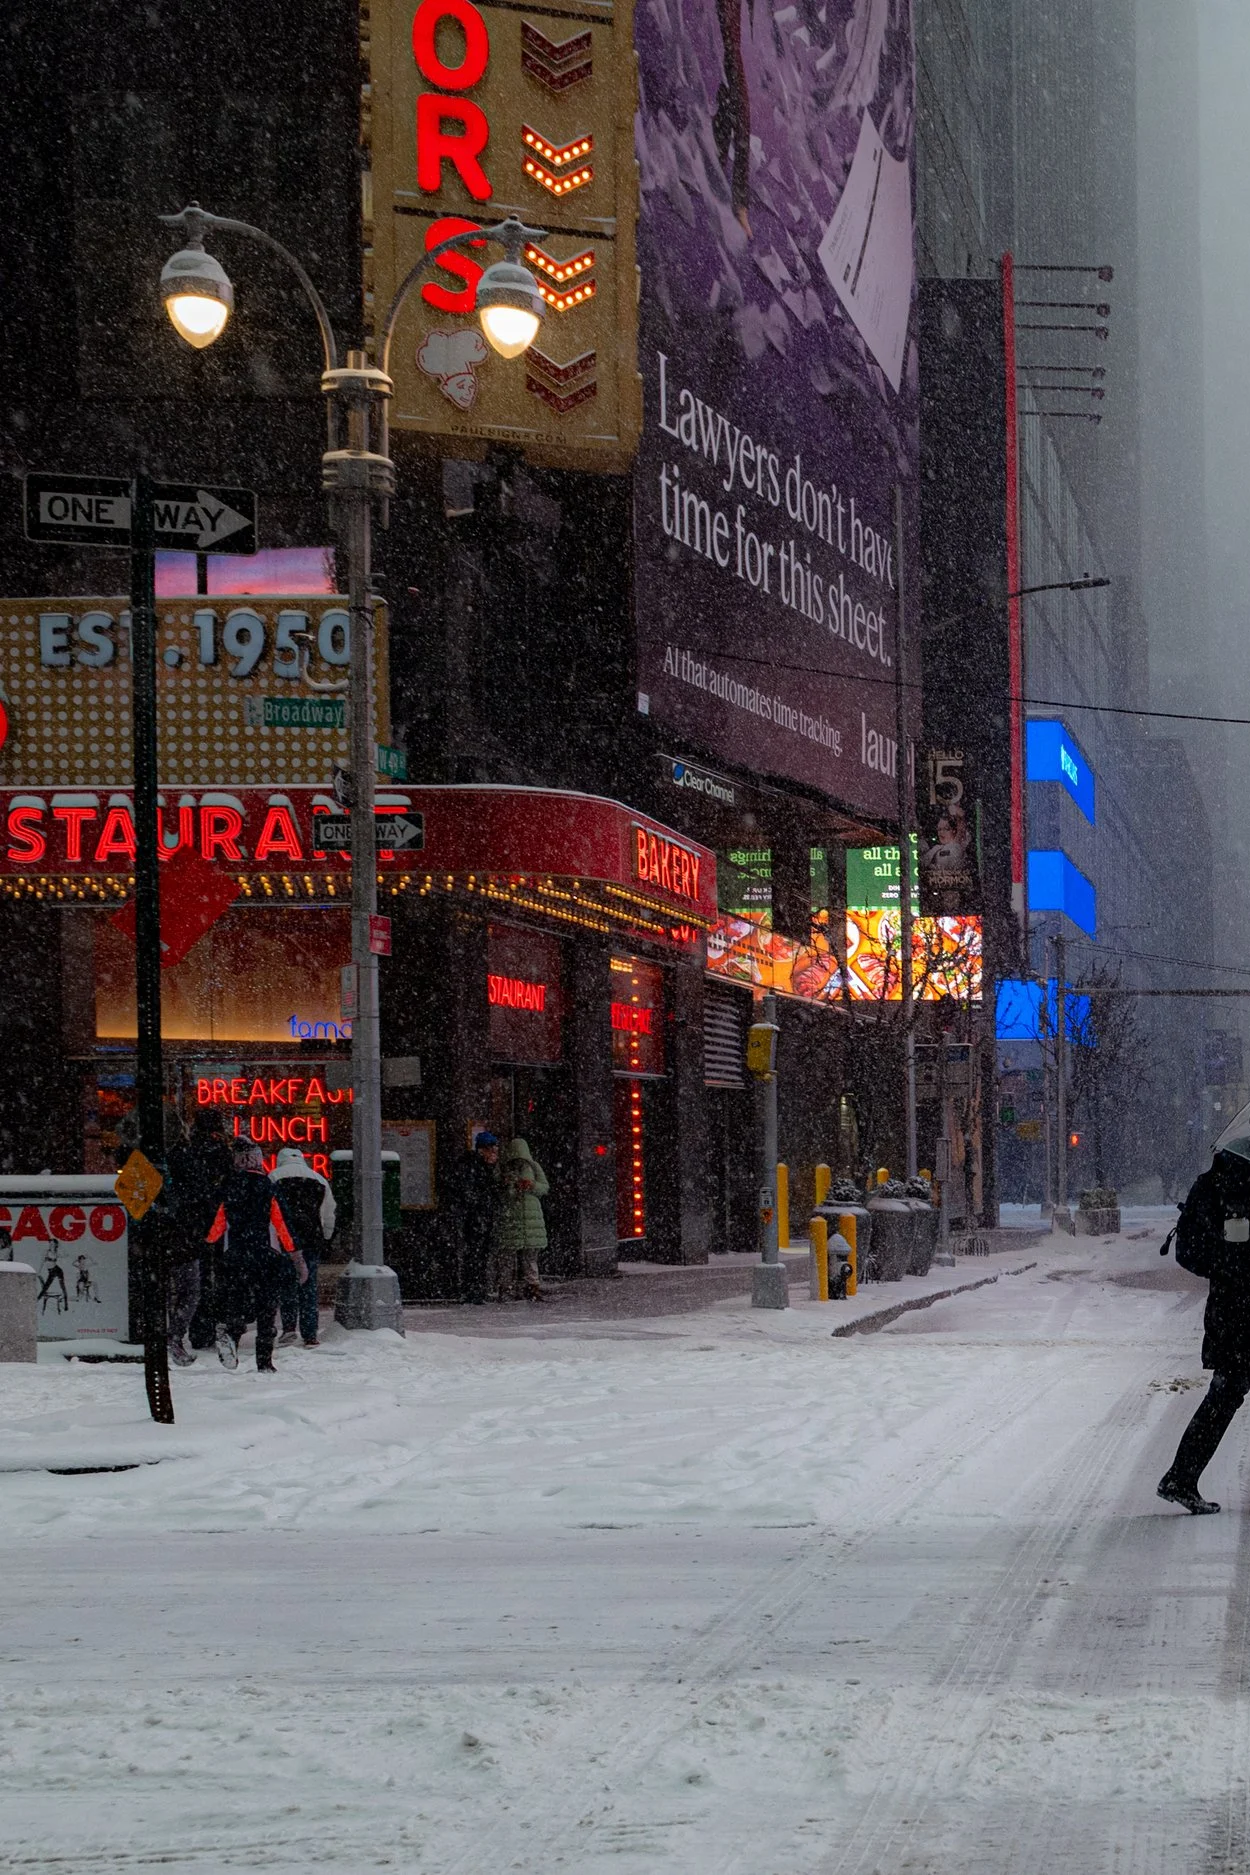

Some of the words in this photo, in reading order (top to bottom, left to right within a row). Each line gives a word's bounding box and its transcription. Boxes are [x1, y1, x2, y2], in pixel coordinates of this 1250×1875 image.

[657, 350, 780, 507] Lawyers
[785, 454, 847, 554] don't
[47, 498, 115, 525] ONE
[155, 503, 224, 533] WAY
[659, 462, 730, 567] time
[735, 504, 773, 594] for
[779, 539, 824, 624] this
[828, 575, 891, 667] sheet.
[194, 610, 351, 679] 1950
[266, 702, 343, 728] Broadway
[663, 645, 679, 678] AI
[681, 650, 709, 691] that
[709, 670, 772, 720] automates
[773, 695, 799, 732] time
[800, 709, 843, 758] tracking.
[861, 711, 915, 788] laurl
[684, 770, 705, 792] Clear
[705, 778, 734, 805] Channel
[928, 760, 964, 805] 15
[637, 827, 701, 902] BAKERY
[863, 847, 881, 860] all
[874, 863, 892, 877] all
